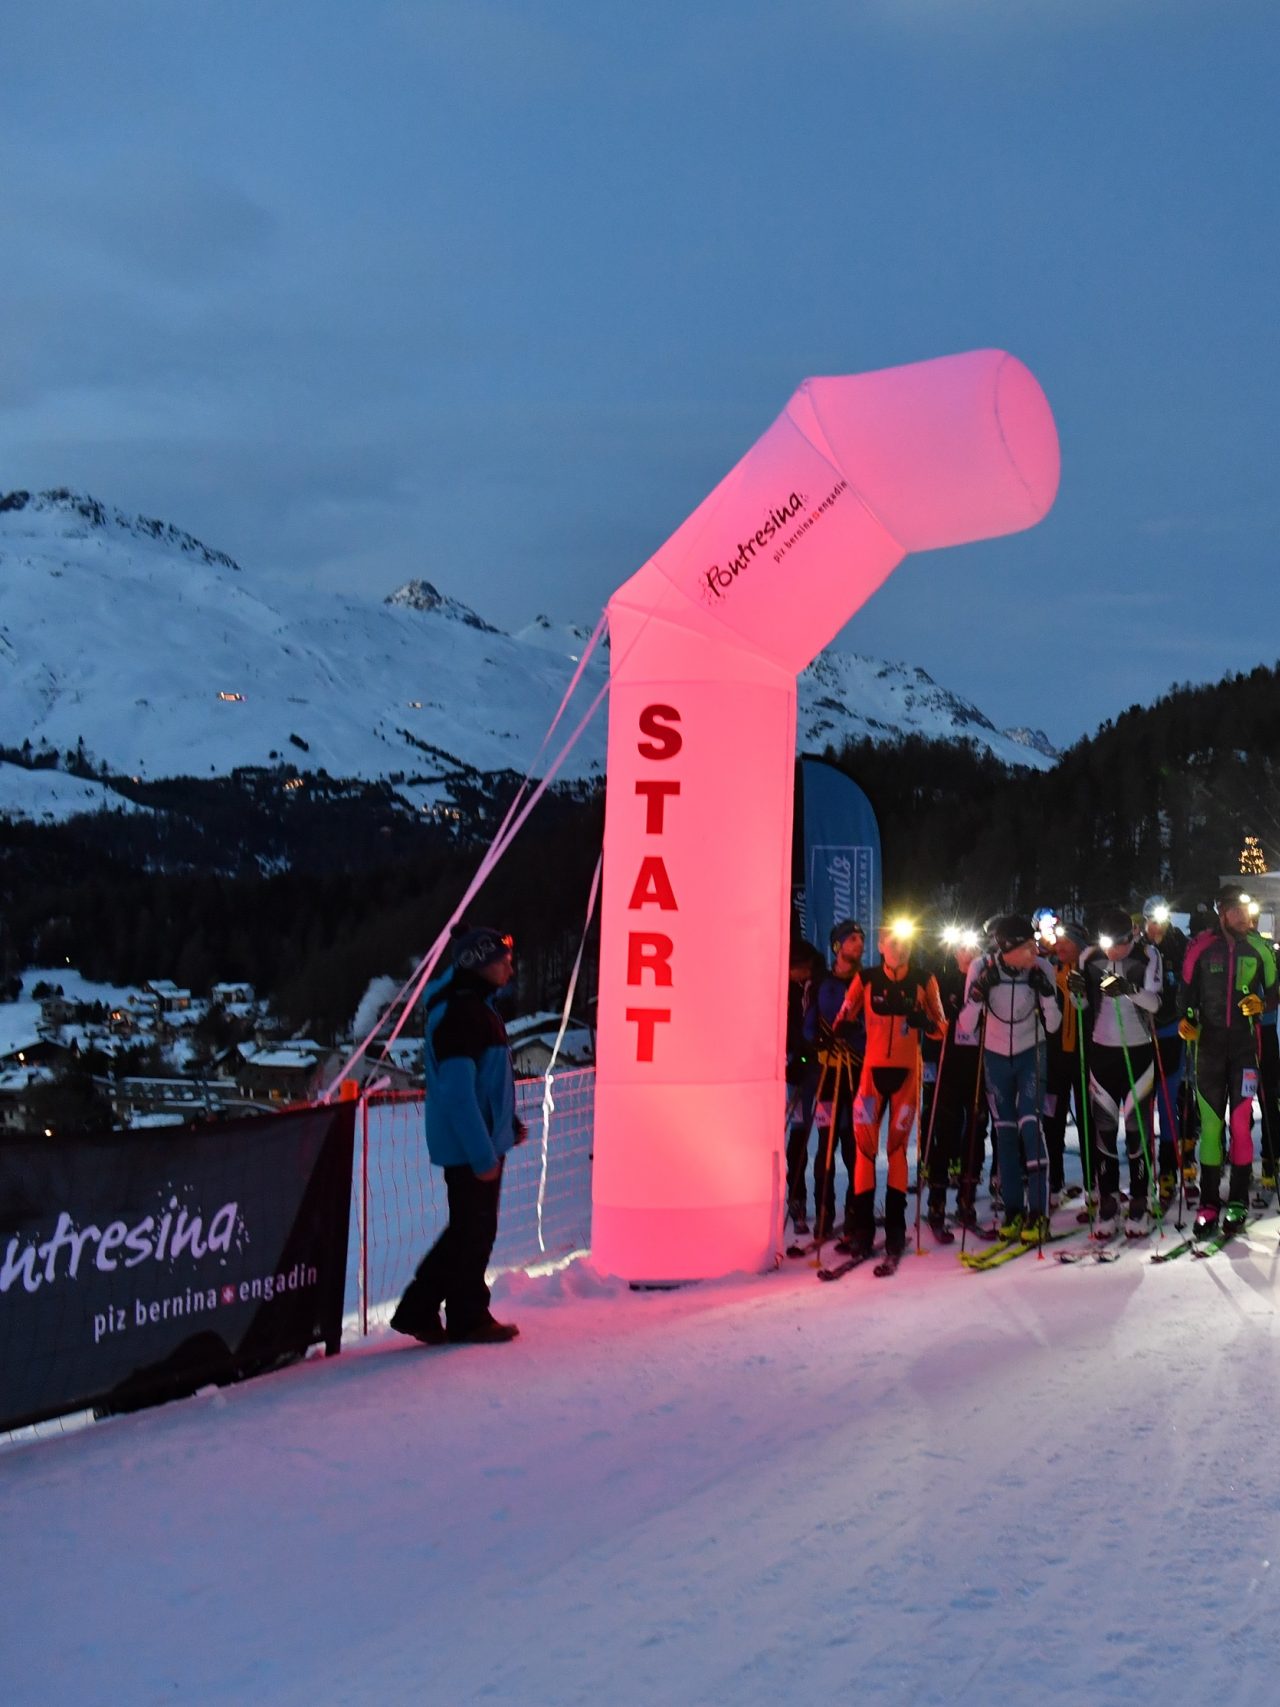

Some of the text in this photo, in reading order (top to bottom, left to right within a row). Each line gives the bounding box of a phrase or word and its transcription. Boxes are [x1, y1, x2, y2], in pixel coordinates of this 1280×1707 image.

[706, 492, 804, 597] Pontresina
[773, 480, 847, 563] piz bernina engadin
[625, 703, 683, 1063] START
[94, 1262, 318, 1344] piz bernina engadin
